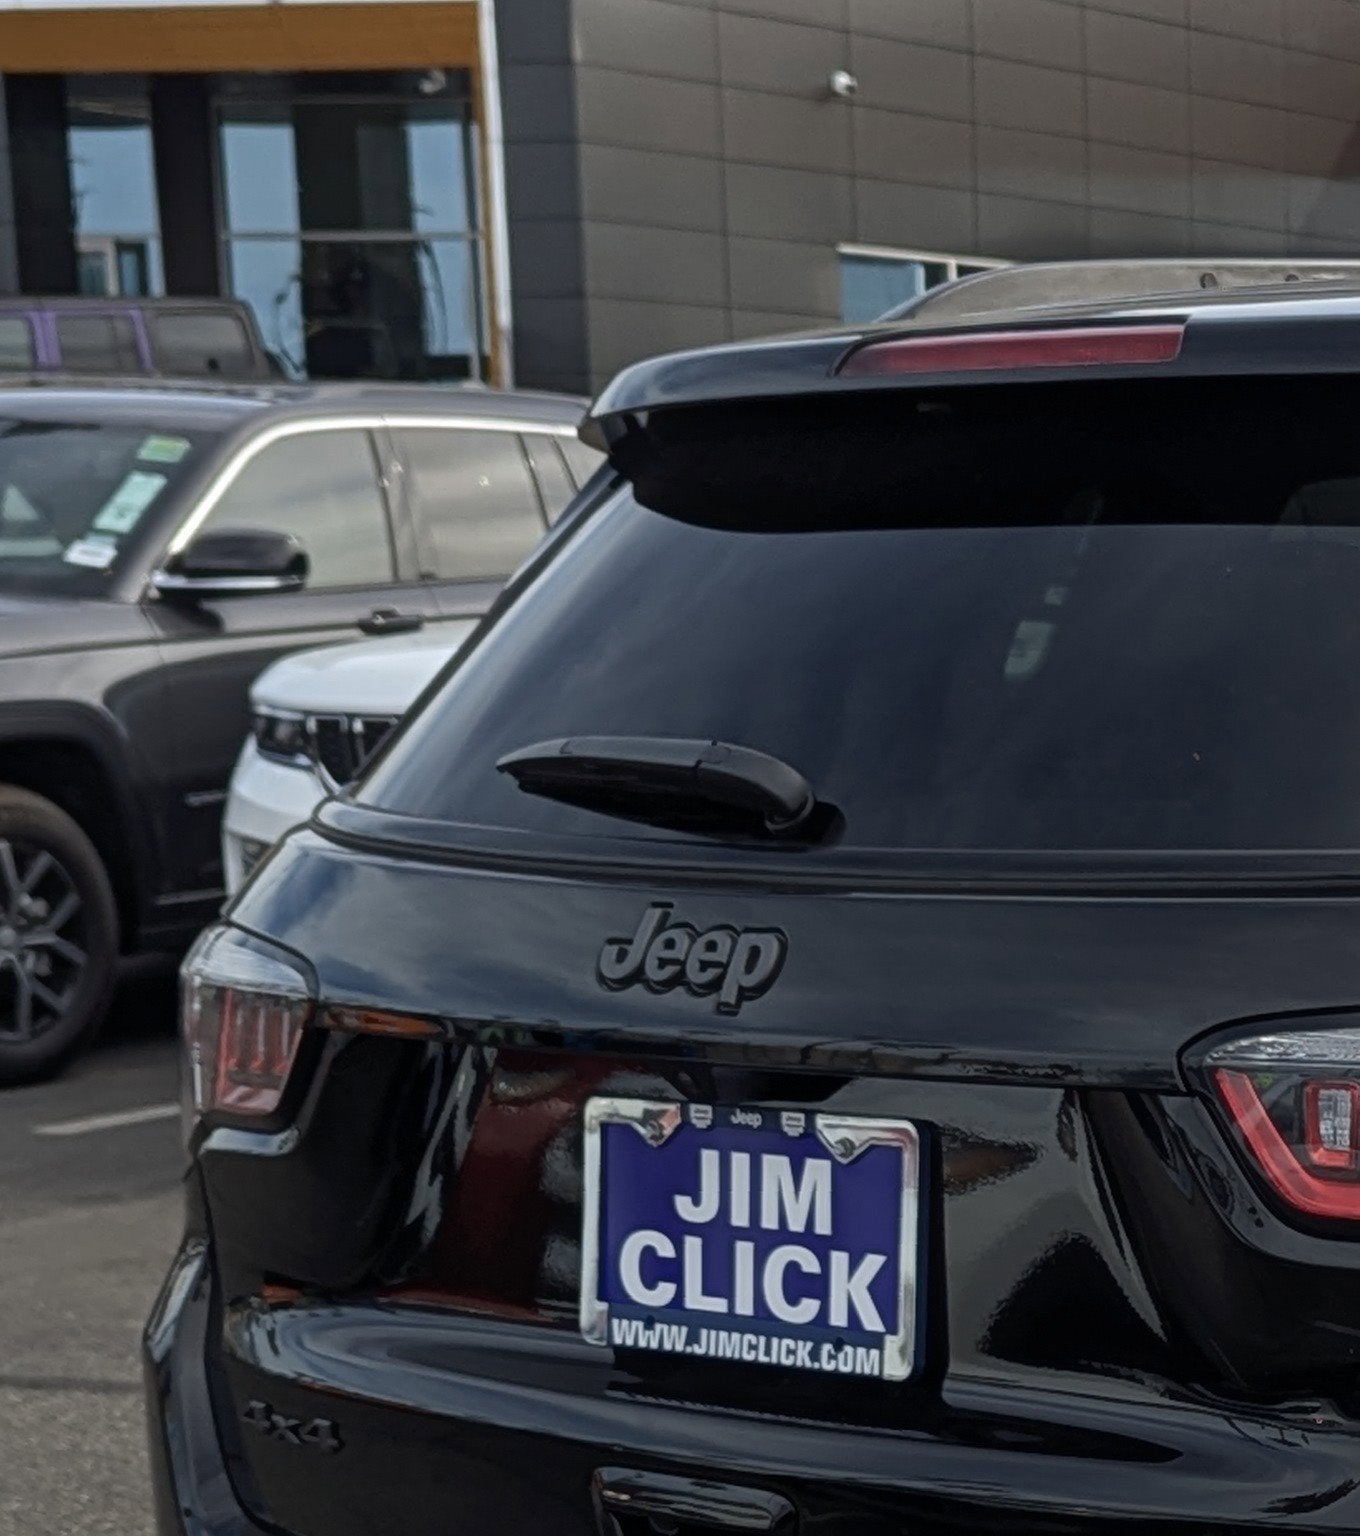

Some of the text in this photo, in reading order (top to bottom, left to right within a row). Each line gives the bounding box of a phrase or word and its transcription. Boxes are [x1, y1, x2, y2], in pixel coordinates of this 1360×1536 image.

[596, 901, 788, 1016] Jeep
[730, 1108, 763, 1129] Jeep
[674, 1148, 833, 1236] JIM
[619, 1229, 887, 1333] CLICK
[611, 1316, 880, 1377] WWW.JIMCLICK.COM
[240, 1400, 341, 1450] 4x4
